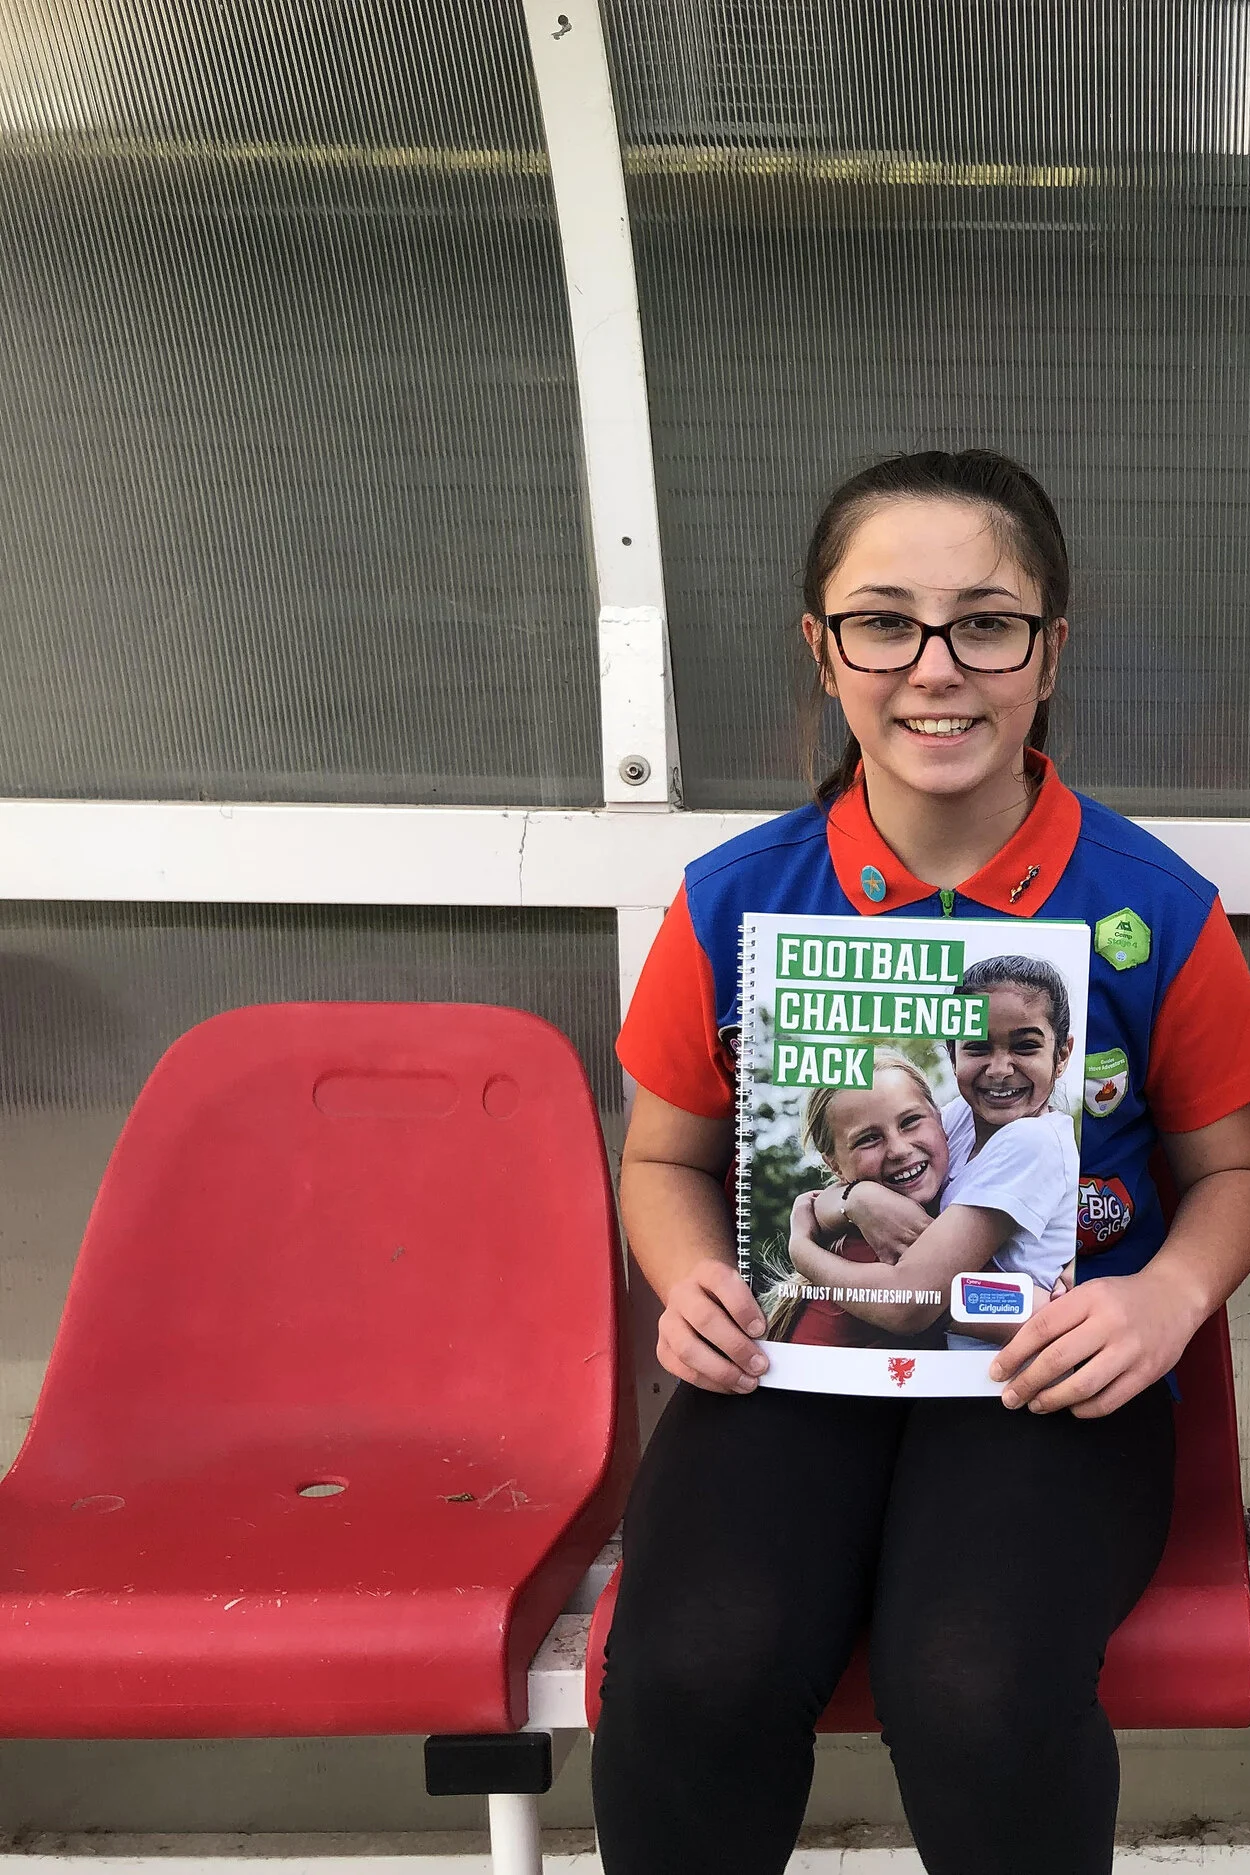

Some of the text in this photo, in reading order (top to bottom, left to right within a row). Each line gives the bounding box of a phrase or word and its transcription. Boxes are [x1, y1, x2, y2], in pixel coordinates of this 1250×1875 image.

[1114, 932, 1133, 940] Camp
[780, 938, 959, 983] FOOTBALL
[779, 992, 984, 1036] CHALLENGE
[777, 1045, 869, 1086] PACK
[1089, 1196, 1121, 1220] BIG
[1097, 1219, 1121, 1242] GIG
[778, 1284, 942, 1305] FAW TRUST IN PARTNERSHIP WITH
[978, 1303, 1020, 1313] Girlguiding
